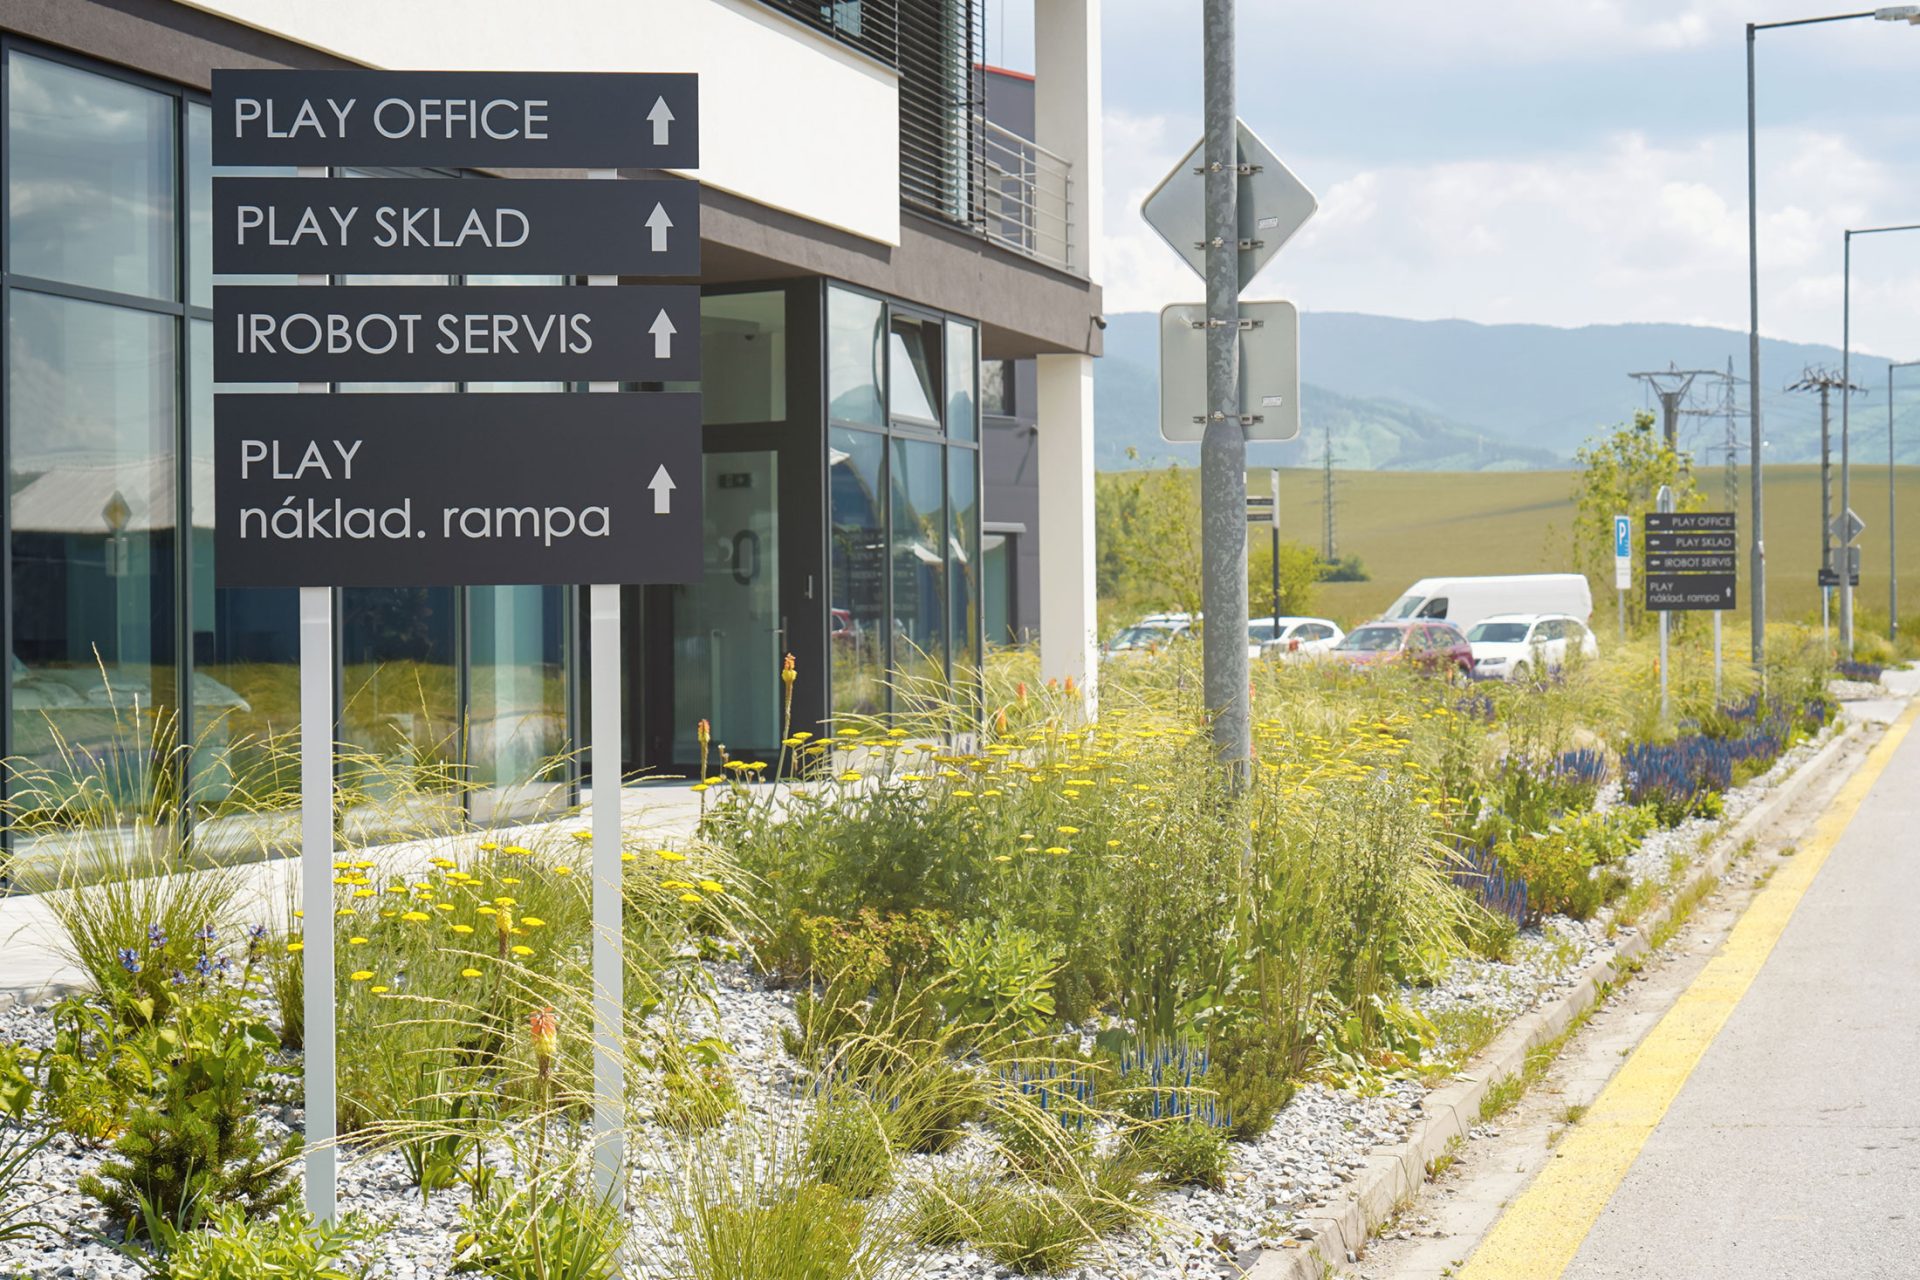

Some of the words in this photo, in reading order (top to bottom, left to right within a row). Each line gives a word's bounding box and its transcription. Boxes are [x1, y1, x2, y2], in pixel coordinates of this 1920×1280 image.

[235, 98, 357, 139] PLAY
[373, 98, 548, 140] OFFICE
[237, 205, 359, 246] PLAY
[373, 206, 530, 248] SKLAD
[237, 313, 422, 355] IROBOT
[435, 313, 593, 355] SERVIS
[241, 439, 363, 480] PLAY
[240, 495, 426, 539] náklad.
[443, 506, 610, 547] rampa
[1618, 521, 1627, 545] P
[1672, 517, 1695, 527] PLAY
[1697, 517, 1731, 527] OFFICE
[1675, 538, 1699, 547] PLAY
[1701, 538, 1731, 547] SKLAD
[1664, 558, 1699, 568] IROBOT
[1701, 557, 1732, 567] SERVIS
[1649, 582, 1674, 591] PLAY
[1687, 594, 1720, 605] rampa
